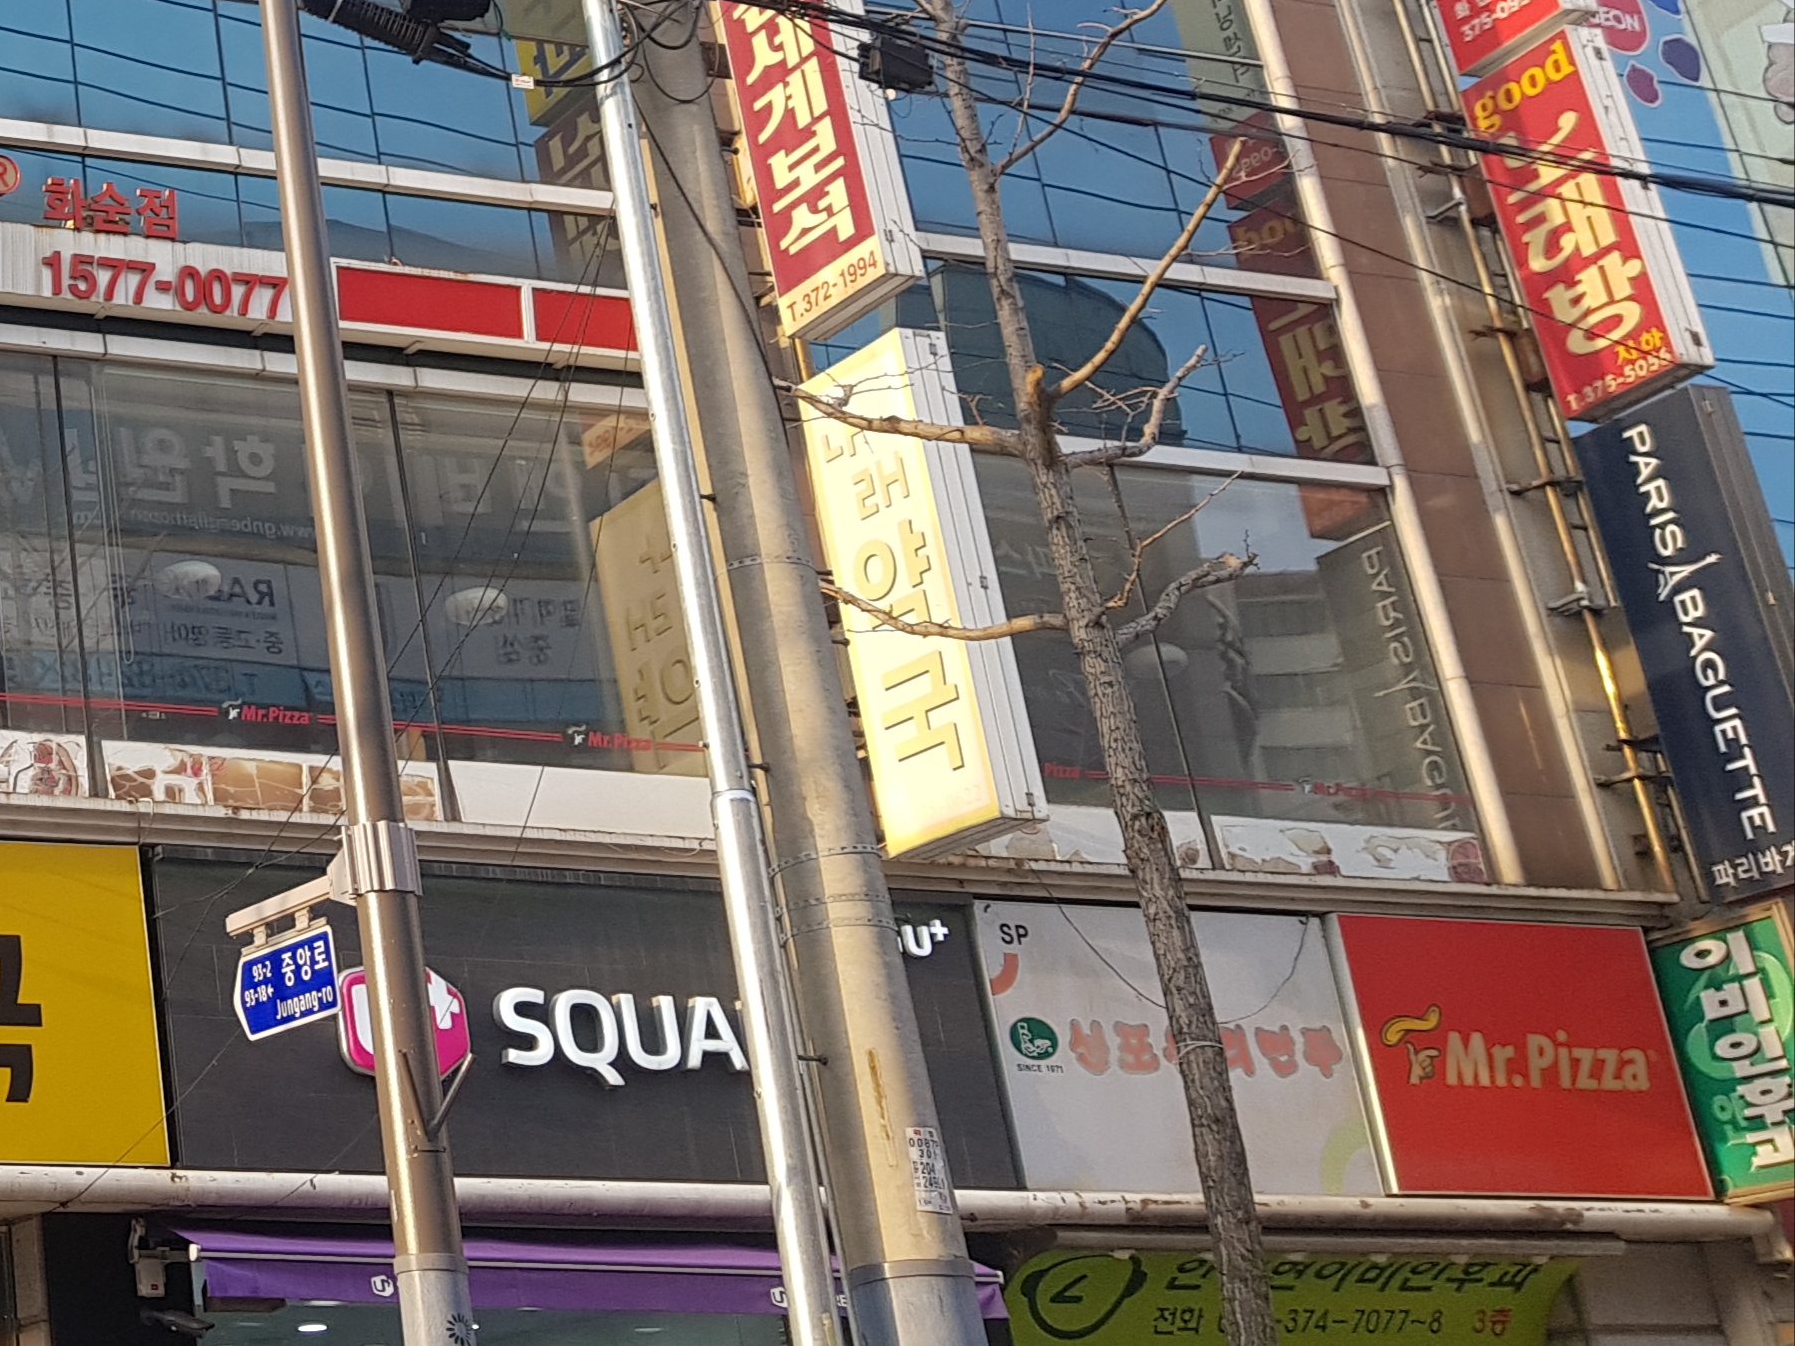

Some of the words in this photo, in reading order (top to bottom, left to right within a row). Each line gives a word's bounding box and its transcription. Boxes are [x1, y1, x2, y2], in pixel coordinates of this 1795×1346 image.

[1474, 39, 1577, 134] good
[42, 177, 179, 240] 화순점
[1501, 110, 1644, 356] 노래방
[42, 251, 289, 320] 1577-0077
[787, 250, 879, 323] T.372-1994
[821, 421, 964, 771] 나래약국
[1621, 421, 1684, 558] PARIS
[1673, 588, 1777, 841] BAGUETTE
[281, 939, 330, 987] 중앙로
[1000, 923, 1029, 946] SP
[244, 985, 268, 1008] 93-18
[252, 961, 273, 982] 93-2
[276, 985, 334, 1020] Jungang-ro
[496, 986, 751, 1086] SQUA
[1444, 1030, 1650, 1092] Mr.Pizza
[1017, 1063, 1043, 1073] SINCE
[1152, 1306, 1204, 1335] 전화
